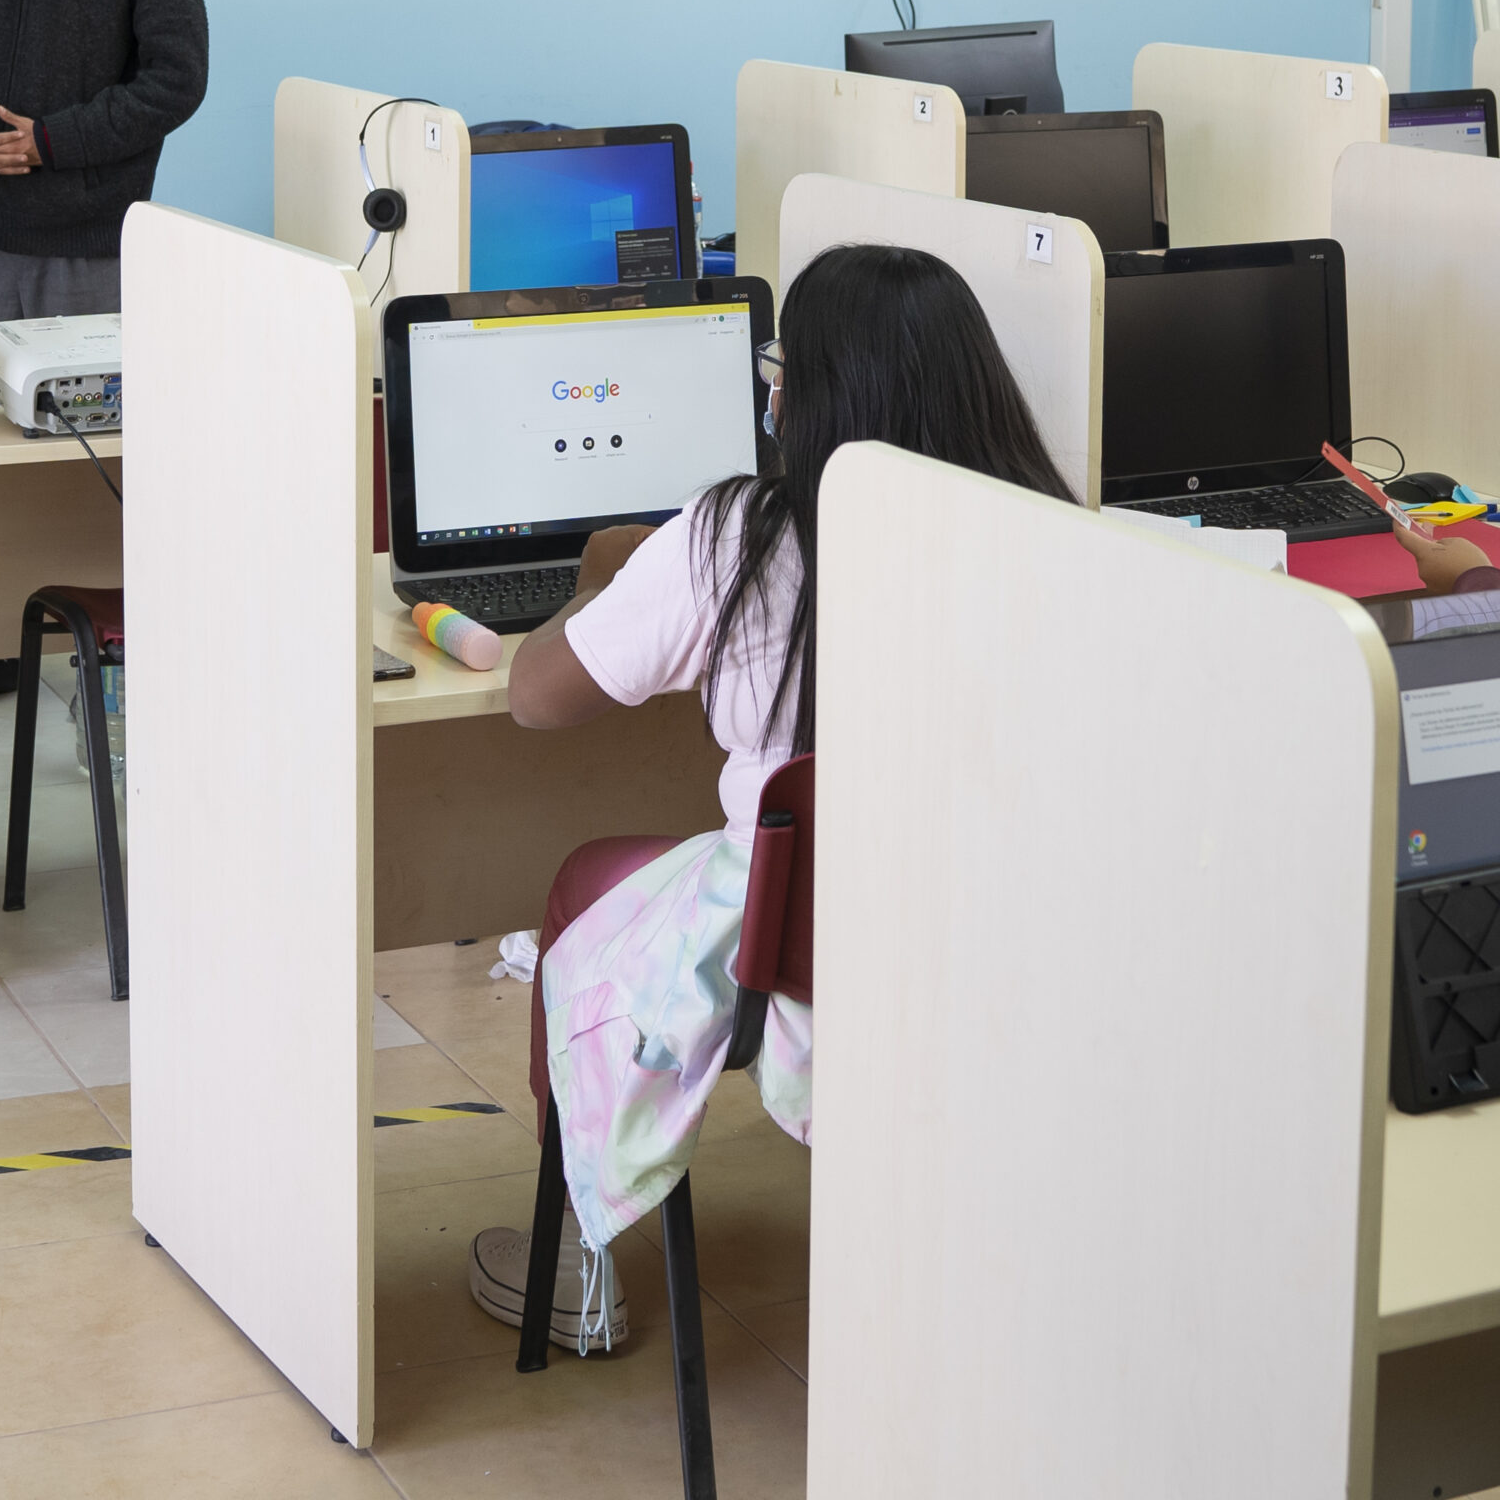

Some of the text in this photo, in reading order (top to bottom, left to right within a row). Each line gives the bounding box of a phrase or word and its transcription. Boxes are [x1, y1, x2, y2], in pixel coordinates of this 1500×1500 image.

[1334, 76, 1344, 97] 3
[919, 100, 927, 114] 2
[430, 127, 436, 141] 1
[1035, 232, 1045, 252] 7
[552, 377, 620, 403] Google
